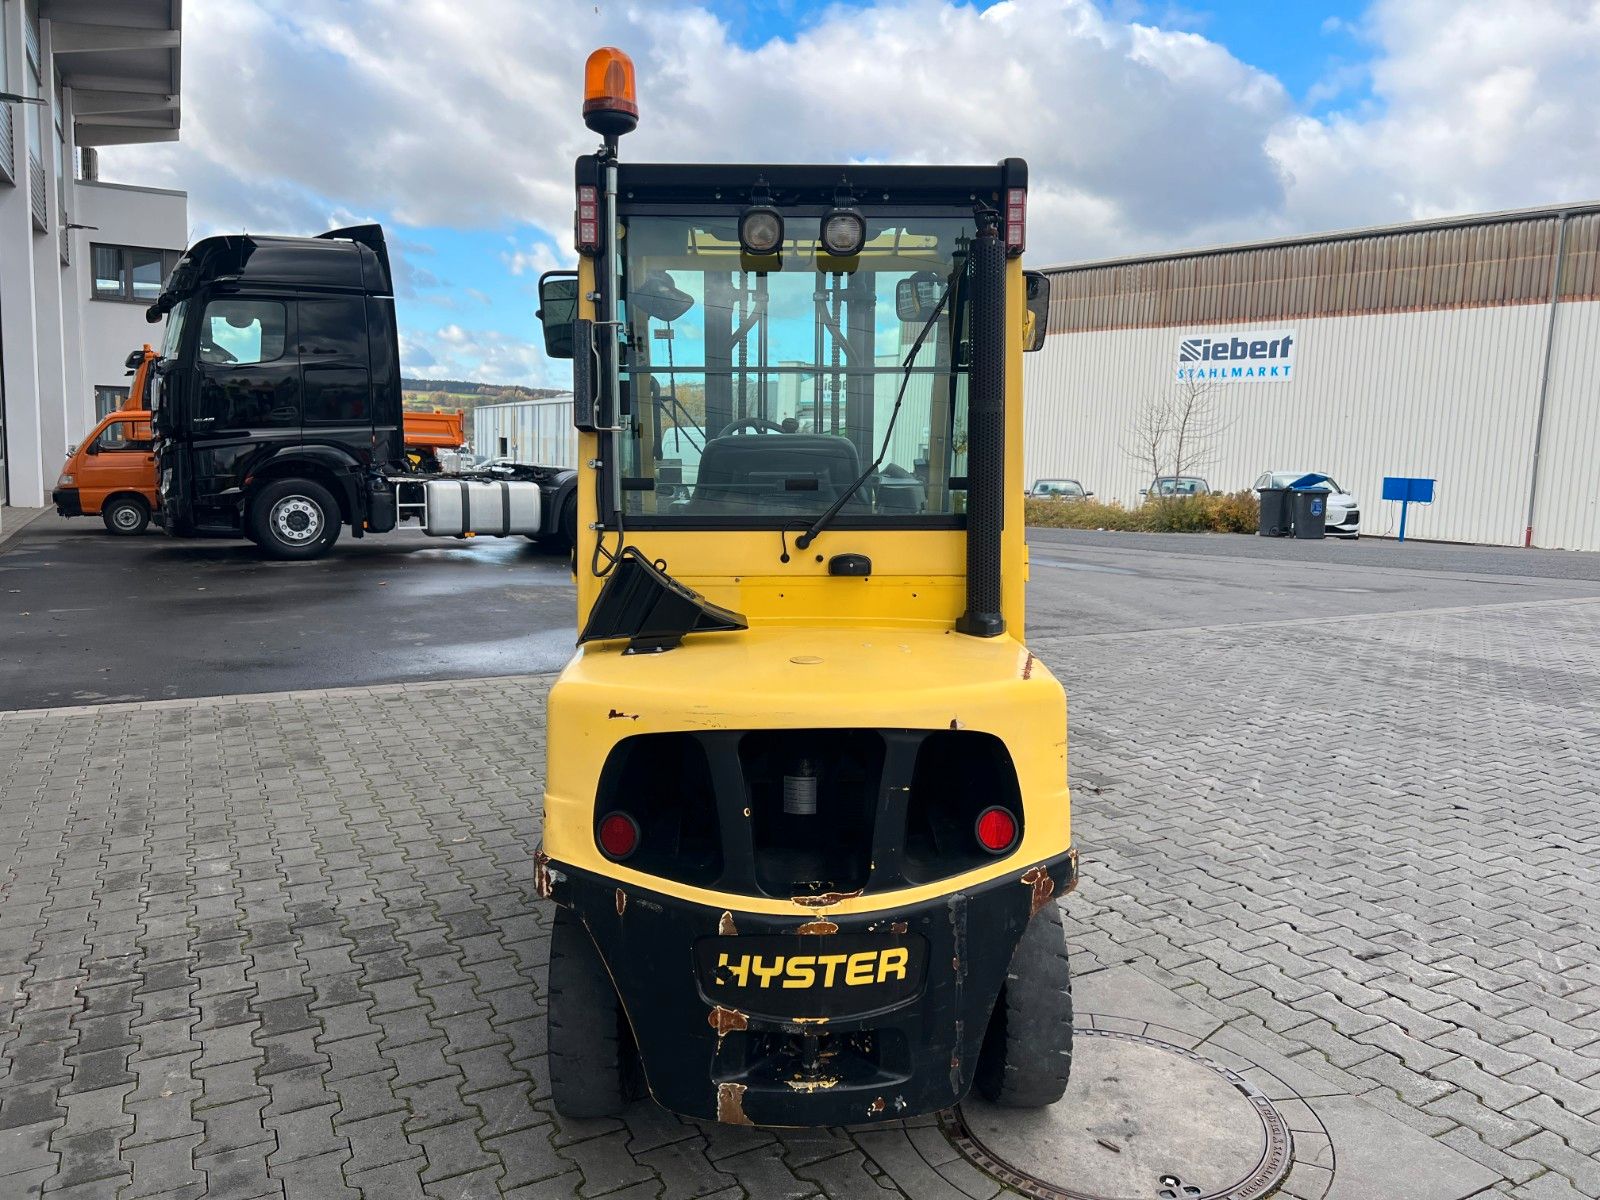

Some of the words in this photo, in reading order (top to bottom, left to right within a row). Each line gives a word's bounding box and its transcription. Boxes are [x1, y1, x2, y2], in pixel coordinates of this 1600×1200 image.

[1179, 335, 1293, 362] Siebert
[1178, 365, 1291, 379] STAHLMARKT
[716, 947, 909, 989] HYSTER
